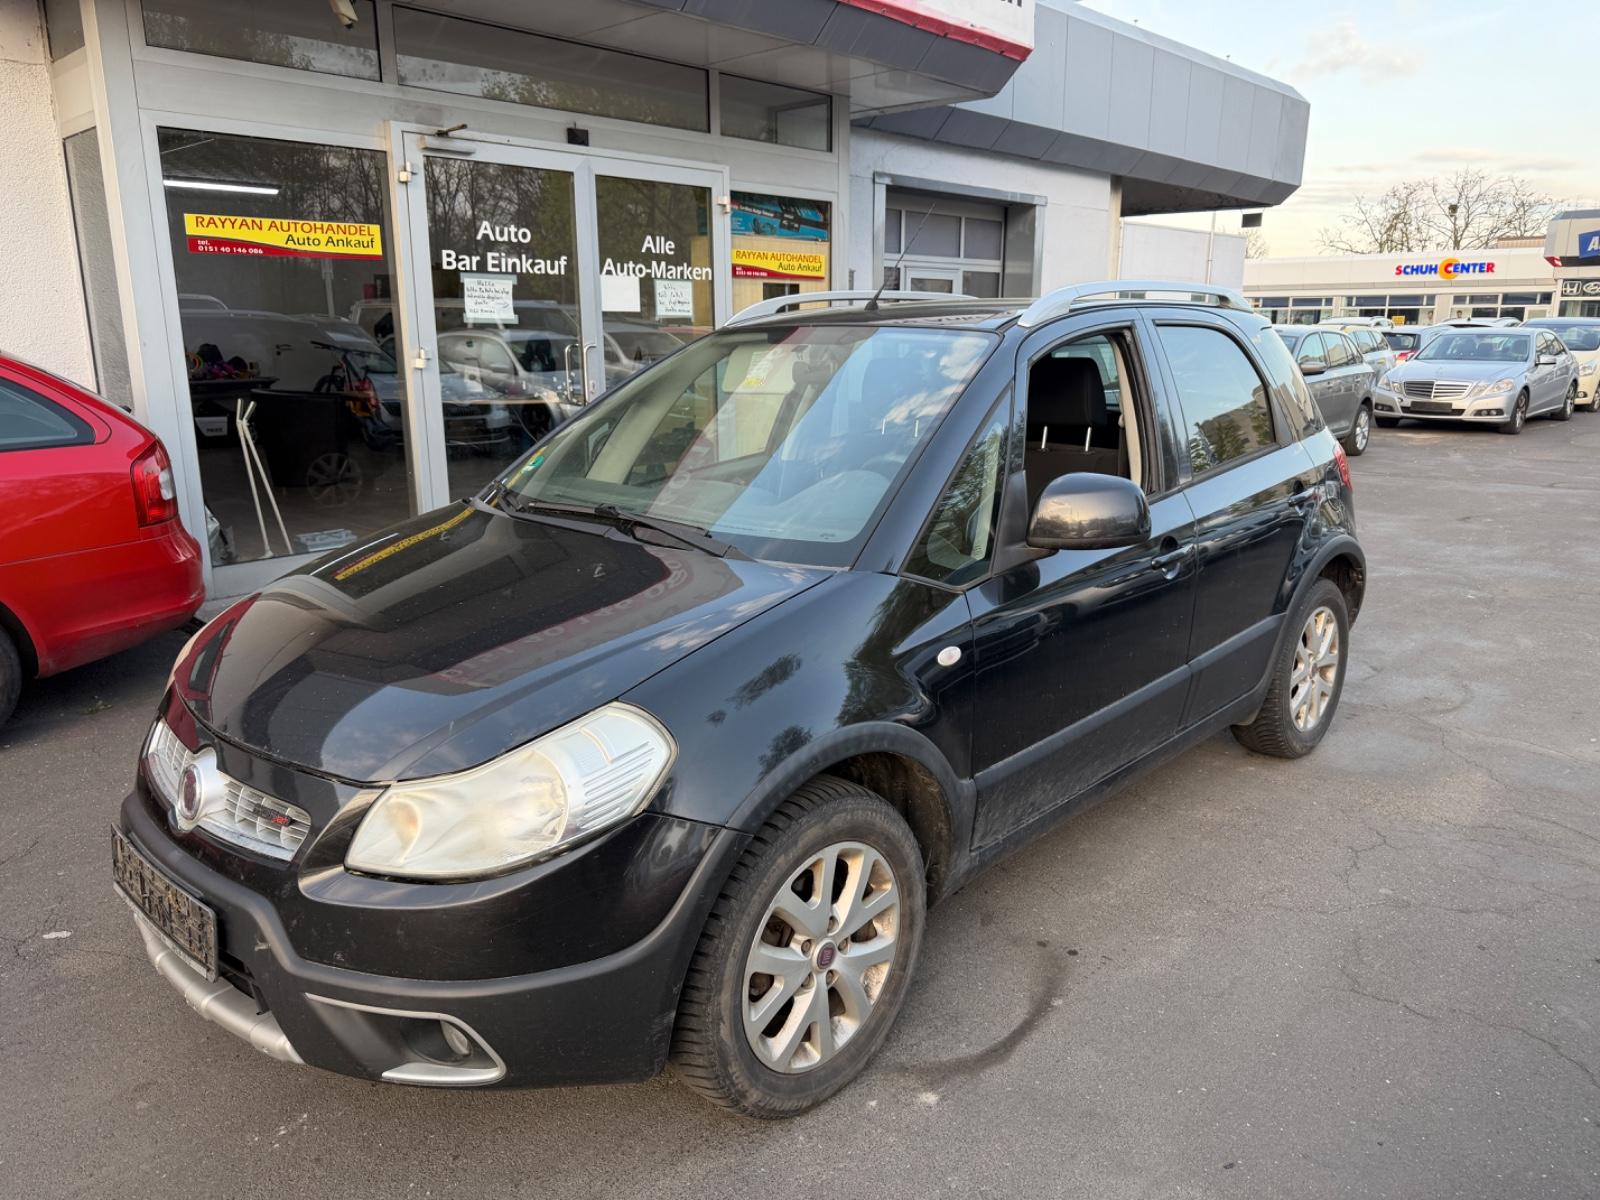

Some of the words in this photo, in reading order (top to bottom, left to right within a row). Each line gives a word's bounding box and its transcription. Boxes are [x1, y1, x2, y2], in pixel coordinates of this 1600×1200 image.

[195, 215, 263, 231] RAYYAN
[268, 220, 374, 236] AUTOHANDEL
[476, 220, 531, 244] Auto
[285, 234, 320, 248] Auto
[326, 236, 375, 249] Ankauf
[641, 235, 675, 255] Alle
[441, 249, 481, 272] Bar
[487, 252, 567, 275] Einkauf
[735, 250, 768, 261] RAYYAN
[770, 252, 822, 264] AUTOHANDEL
[777, 262, 796, 271] Auto
[797, 263, 822, 272] Ankauf
[601, 257, 713, 281] Auto-Marken
[1395, 264, 1438, 275] SCHUH
[1443, 262, 1496, 274] CENTER
